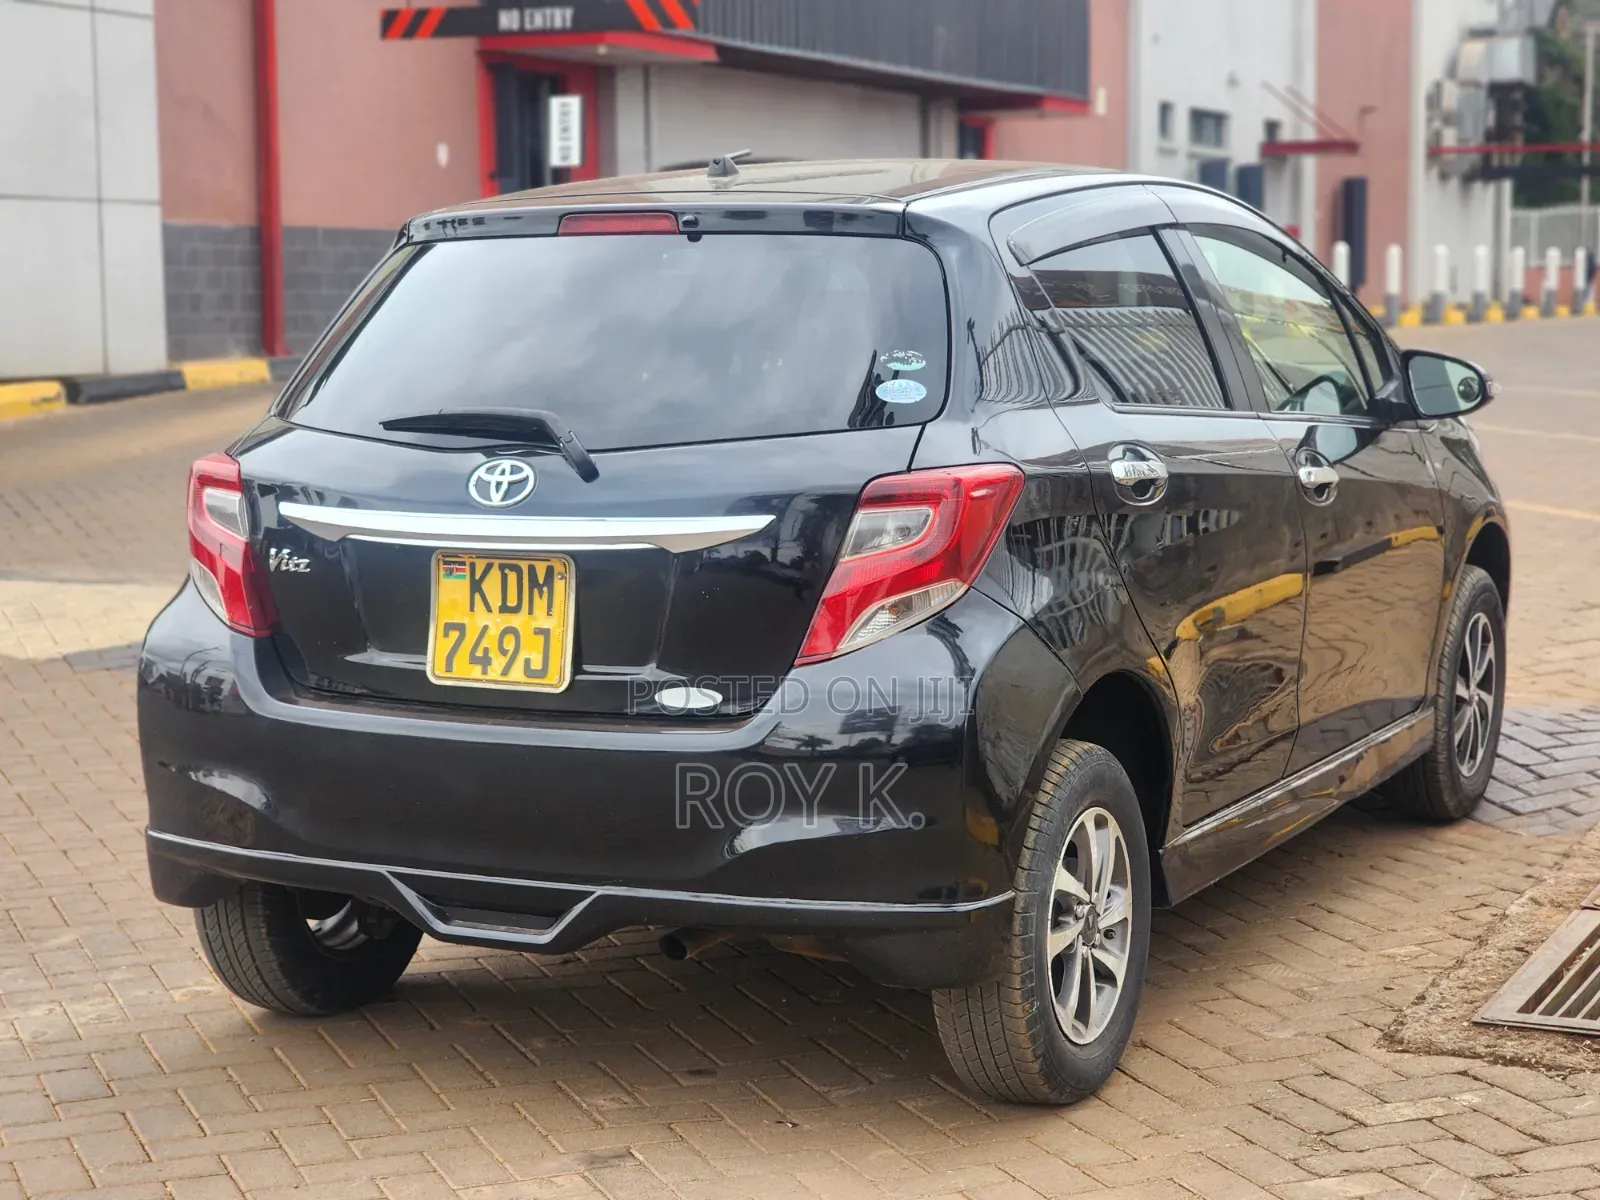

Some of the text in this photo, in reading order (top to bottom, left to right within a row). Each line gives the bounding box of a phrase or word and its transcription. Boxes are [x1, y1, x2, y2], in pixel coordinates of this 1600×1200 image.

[499, 6, 573, 31] NO ENTRY
[269, 547, 310, 572] Vitz
[469, 561, 554, 616] KDM
[442, 622, 551, 678] 749J
